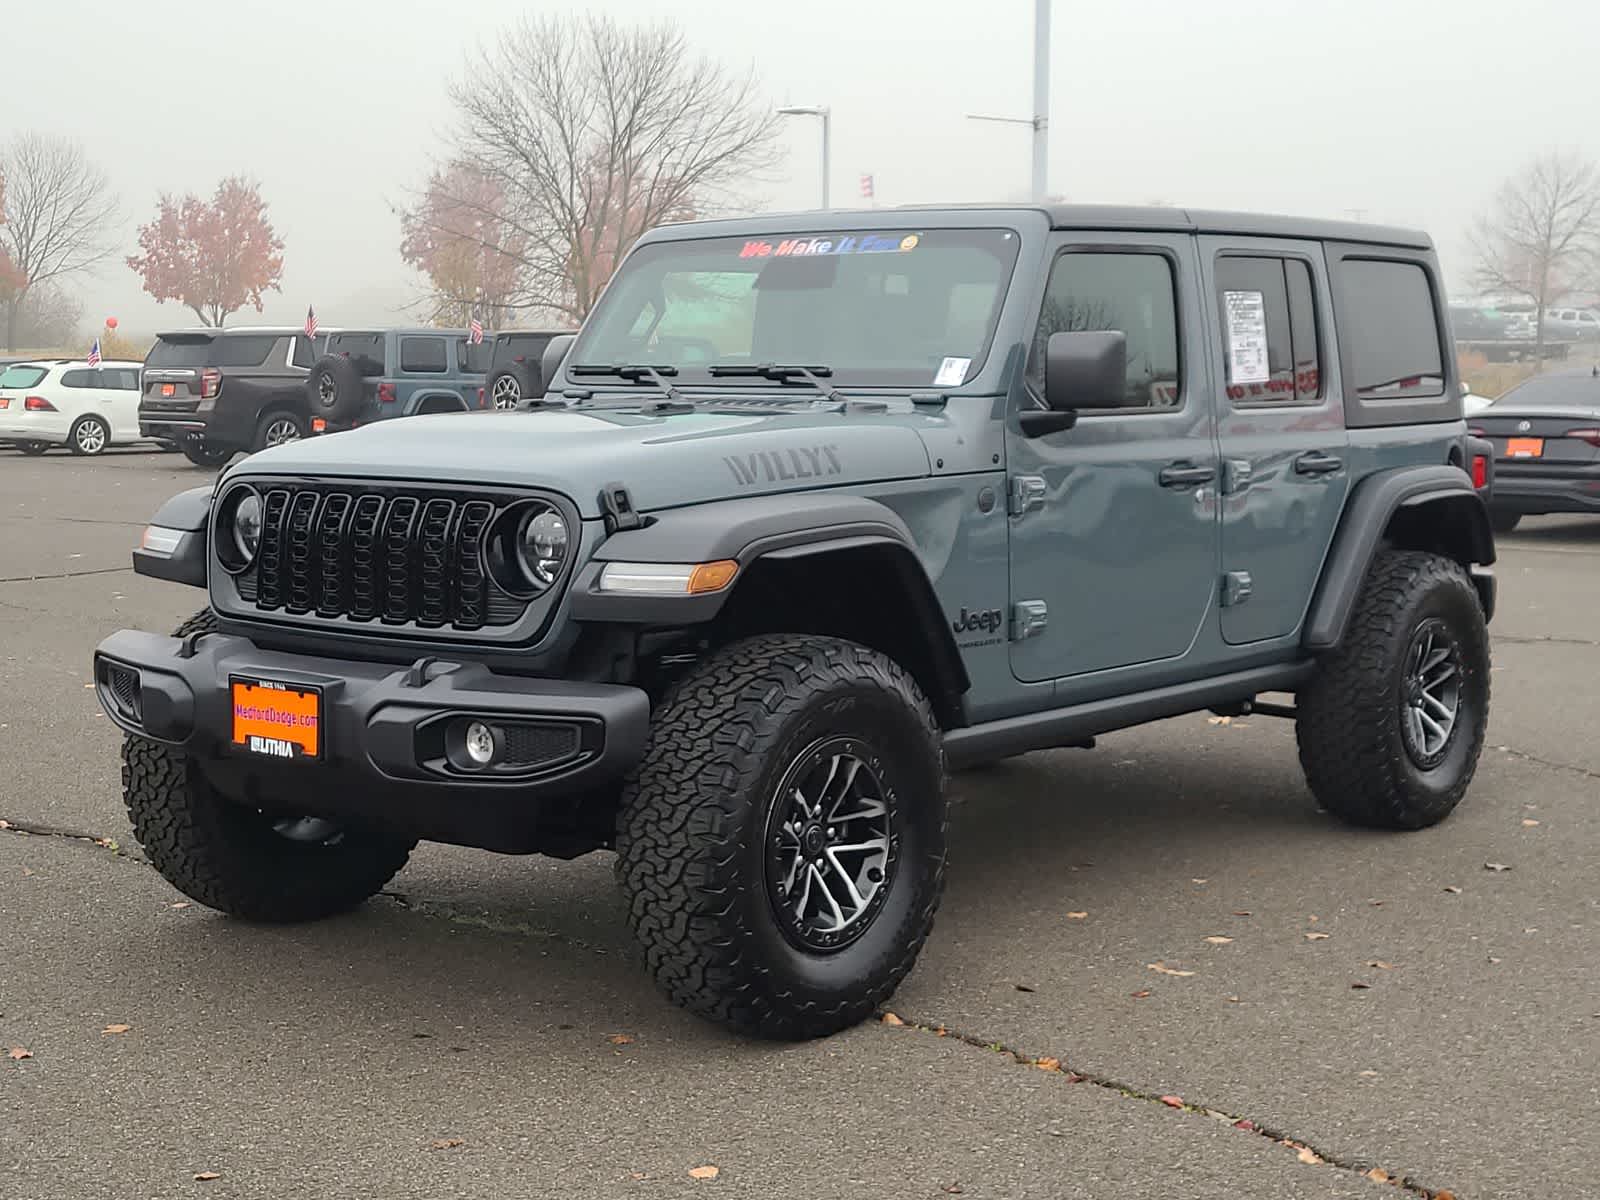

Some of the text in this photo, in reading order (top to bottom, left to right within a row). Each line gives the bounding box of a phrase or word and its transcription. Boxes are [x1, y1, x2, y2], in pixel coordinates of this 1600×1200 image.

[739, 240, 773, 258] We
[775, 237, 833, 256] Make
[721, 445, 842, 486] WILLYS
[953, 607, 1002, 633] Jeep
